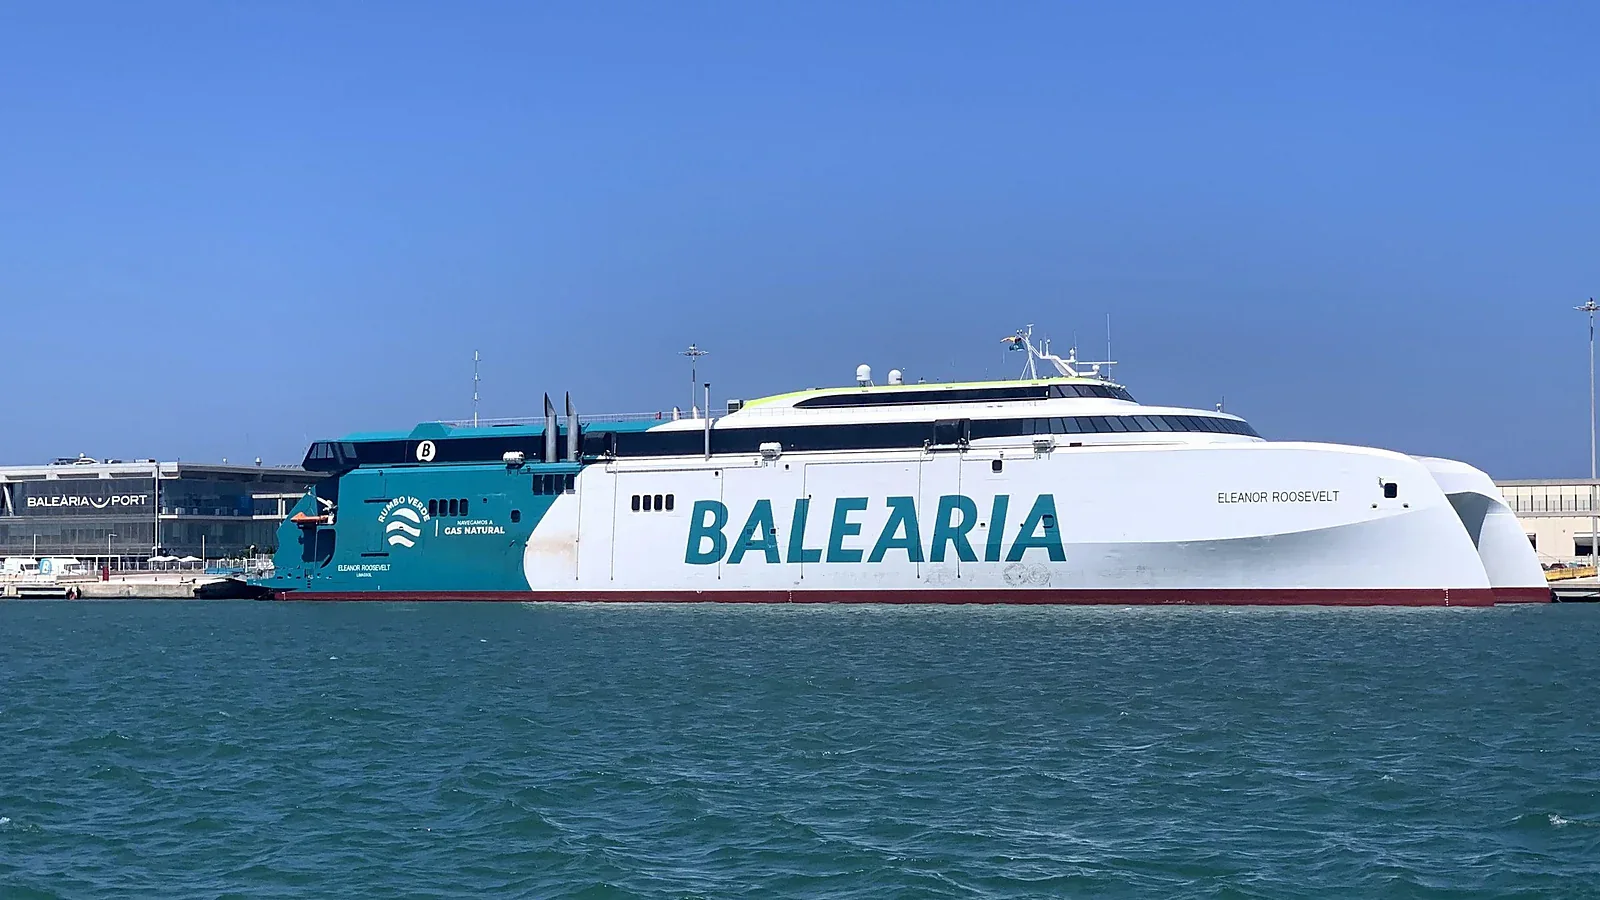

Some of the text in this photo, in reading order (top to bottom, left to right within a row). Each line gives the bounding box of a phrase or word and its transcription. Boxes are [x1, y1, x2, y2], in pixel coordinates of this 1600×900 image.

[421, 443, 431, 457] B
[27, 494, 148, 507] BALEÀRIA PORT
[1217, 490, 1340, 504] ELEANOR ROOSEVELT
[378, 495, 431, 523] RUMBO VERDE
[444, 526, 506, 535] GAS NATURAL
[337, 564, 391, 572] ELEANOR ROOSEVELT
